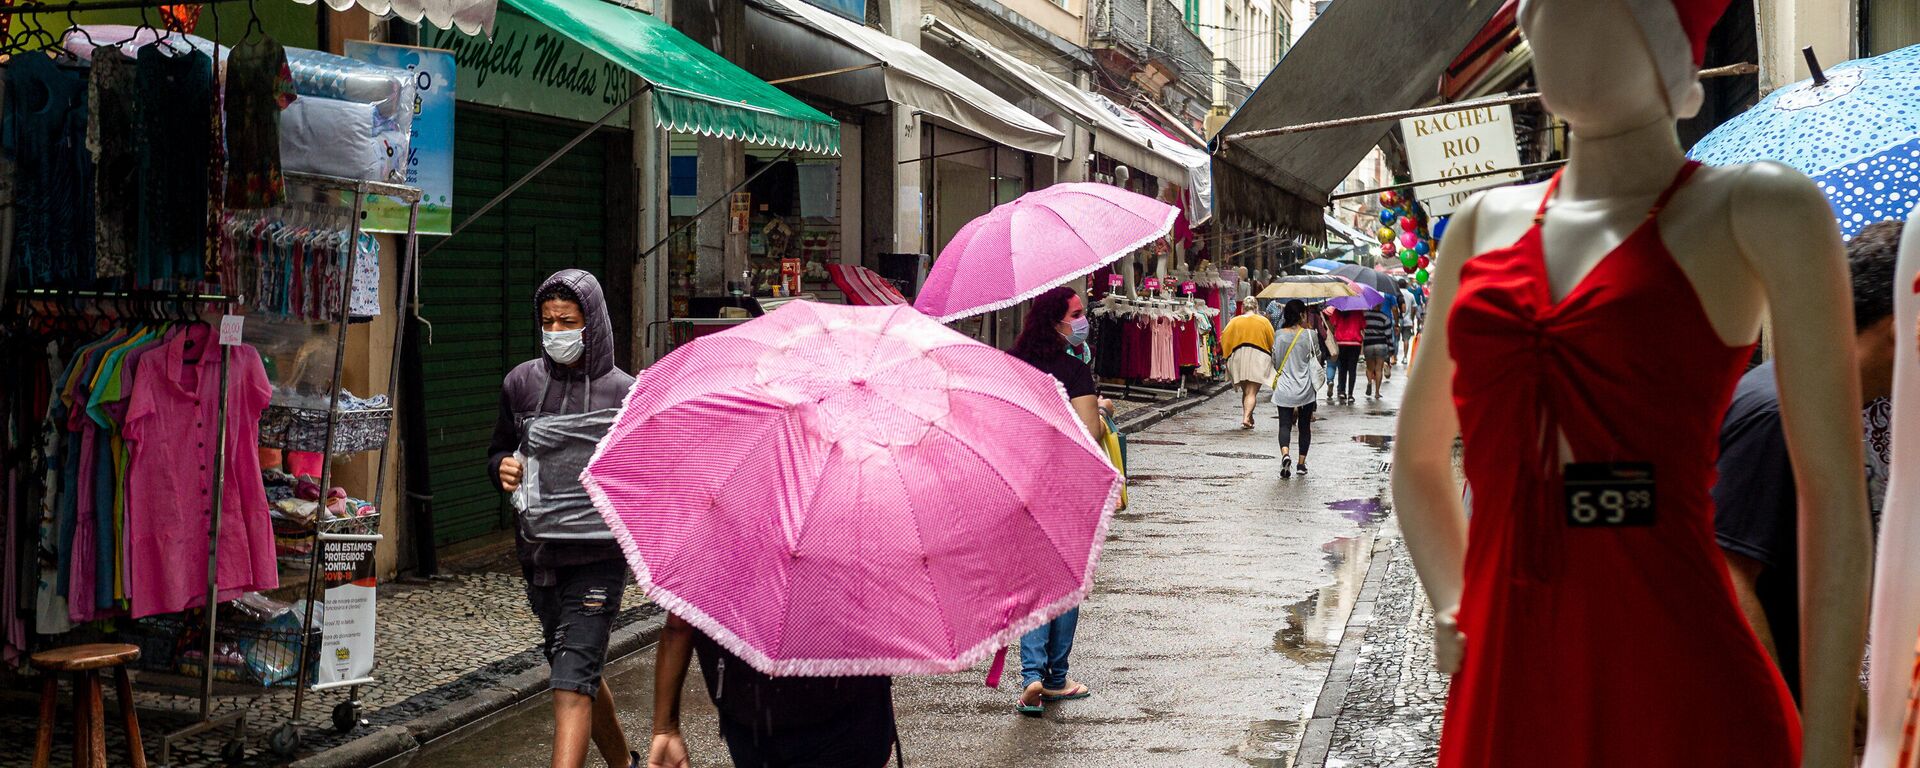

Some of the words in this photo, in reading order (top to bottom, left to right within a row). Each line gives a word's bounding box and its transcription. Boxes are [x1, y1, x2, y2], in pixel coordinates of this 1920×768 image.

[532, 33, 597, 96] Modas
[603, 61, 626, 106] 293
[1413, 106, 1500, 137] RACHEL
[1442, 135, 1480, 159] RIO
[325, 543, 341, 551] AQUI
[342, 543, 373, 551] ESTAMOS
